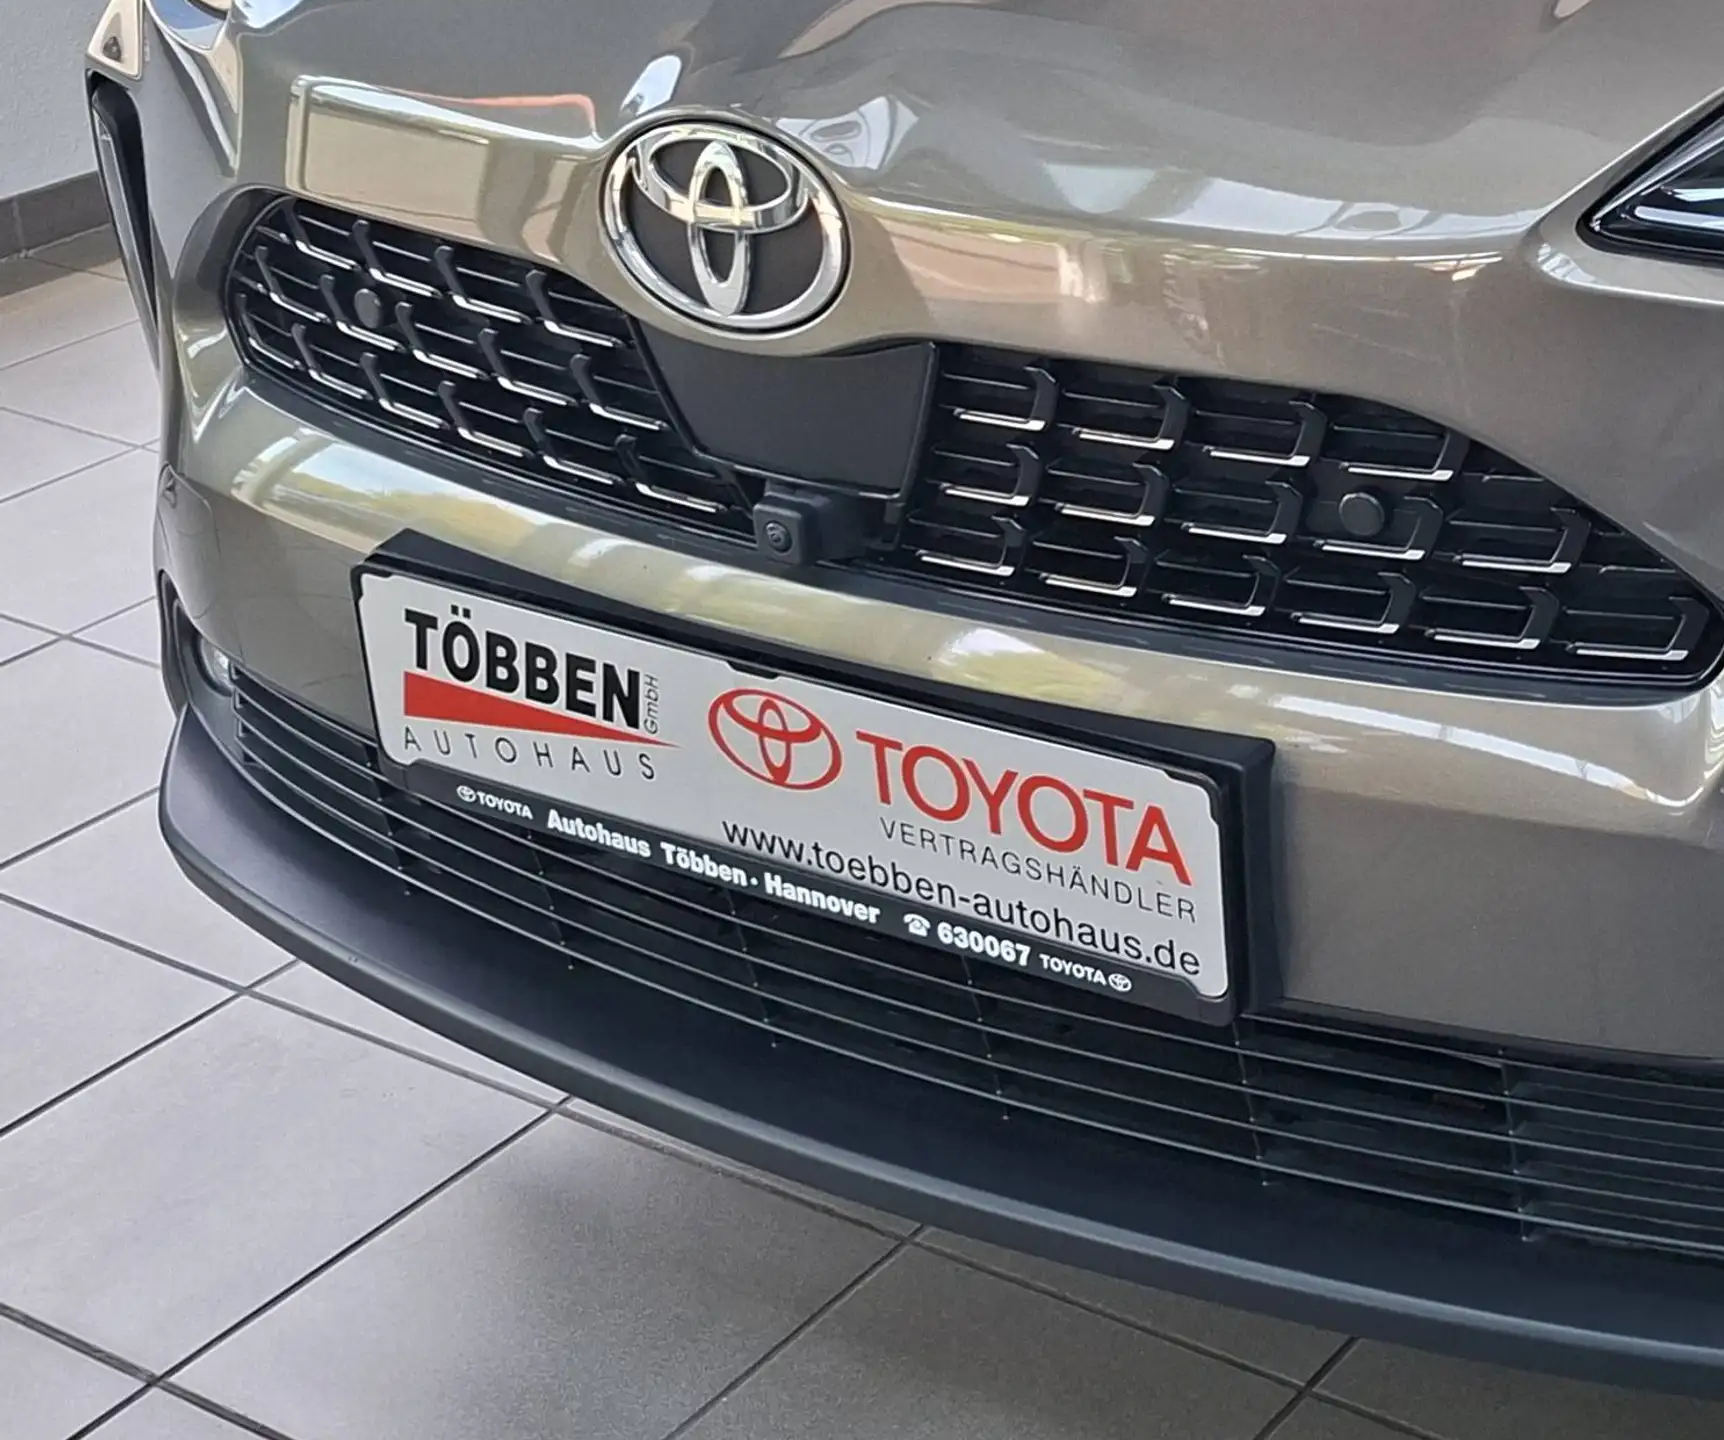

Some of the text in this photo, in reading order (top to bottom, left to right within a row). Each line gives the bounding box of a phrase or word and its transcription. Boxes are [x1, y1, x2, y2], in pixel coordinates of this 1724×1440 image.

[404, 604, 660, 735] TÖBBEN GmbH
[403, 726, 656, 781] AUTOHAUS
[856, 730, 1193, 886] TOYOTA
[477, 791, 1107, 987] TOYOTA Autohaus Többen Hannover 630067 TOYOTA
[722, 820, 1201, 976] www.toebben-autohaus.de
[879, 816, 1197, 924] VERTRAGSHÄNDLER
